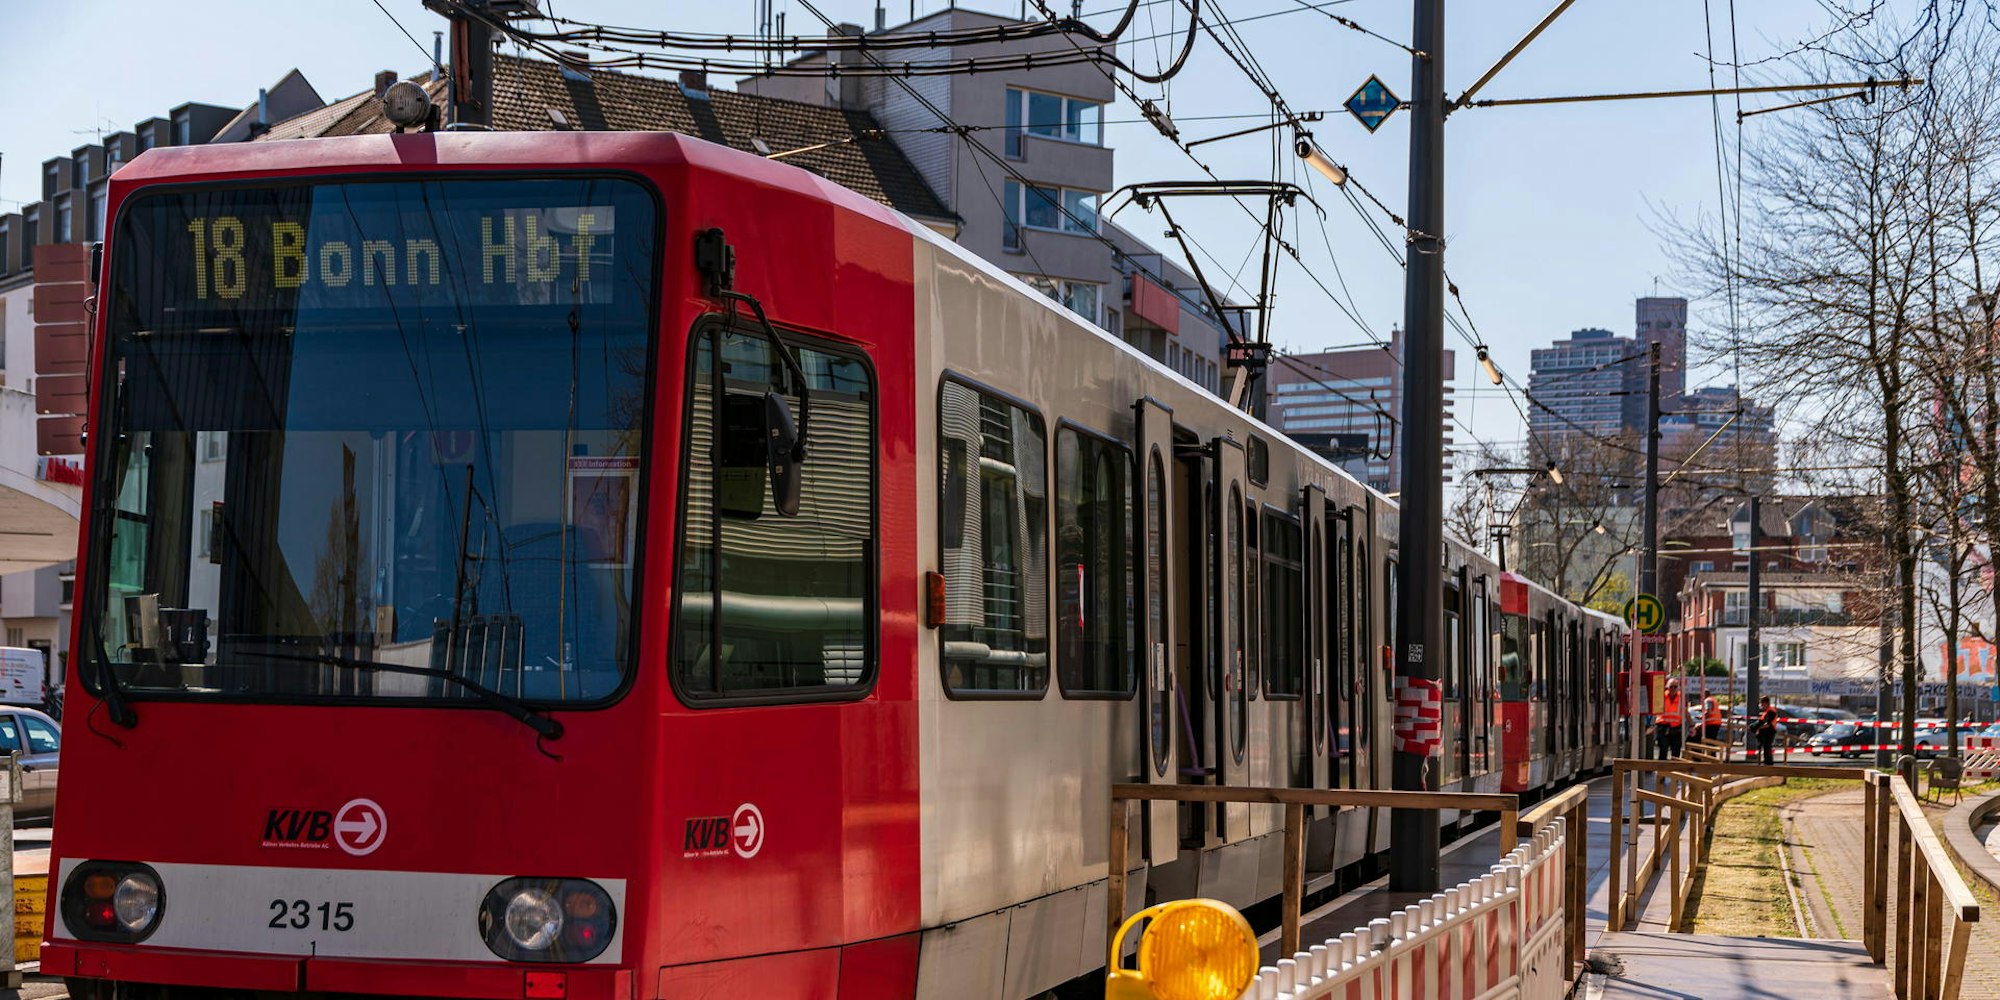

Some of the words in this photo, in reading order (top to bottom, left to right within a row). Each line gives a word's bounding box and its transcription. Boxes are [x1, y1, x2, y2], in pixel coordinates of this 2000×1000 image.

[188, 216, 246, 299] 18
[272, 222, 441, 289] Bonn
[482, 214, 596, 285] Hbf
[1637, 604, 1653, 625] H
[264, 809, 332, 841] KVB
[684, 818, 730, 851] KVB
[268, 898, 354, 932] 2315
